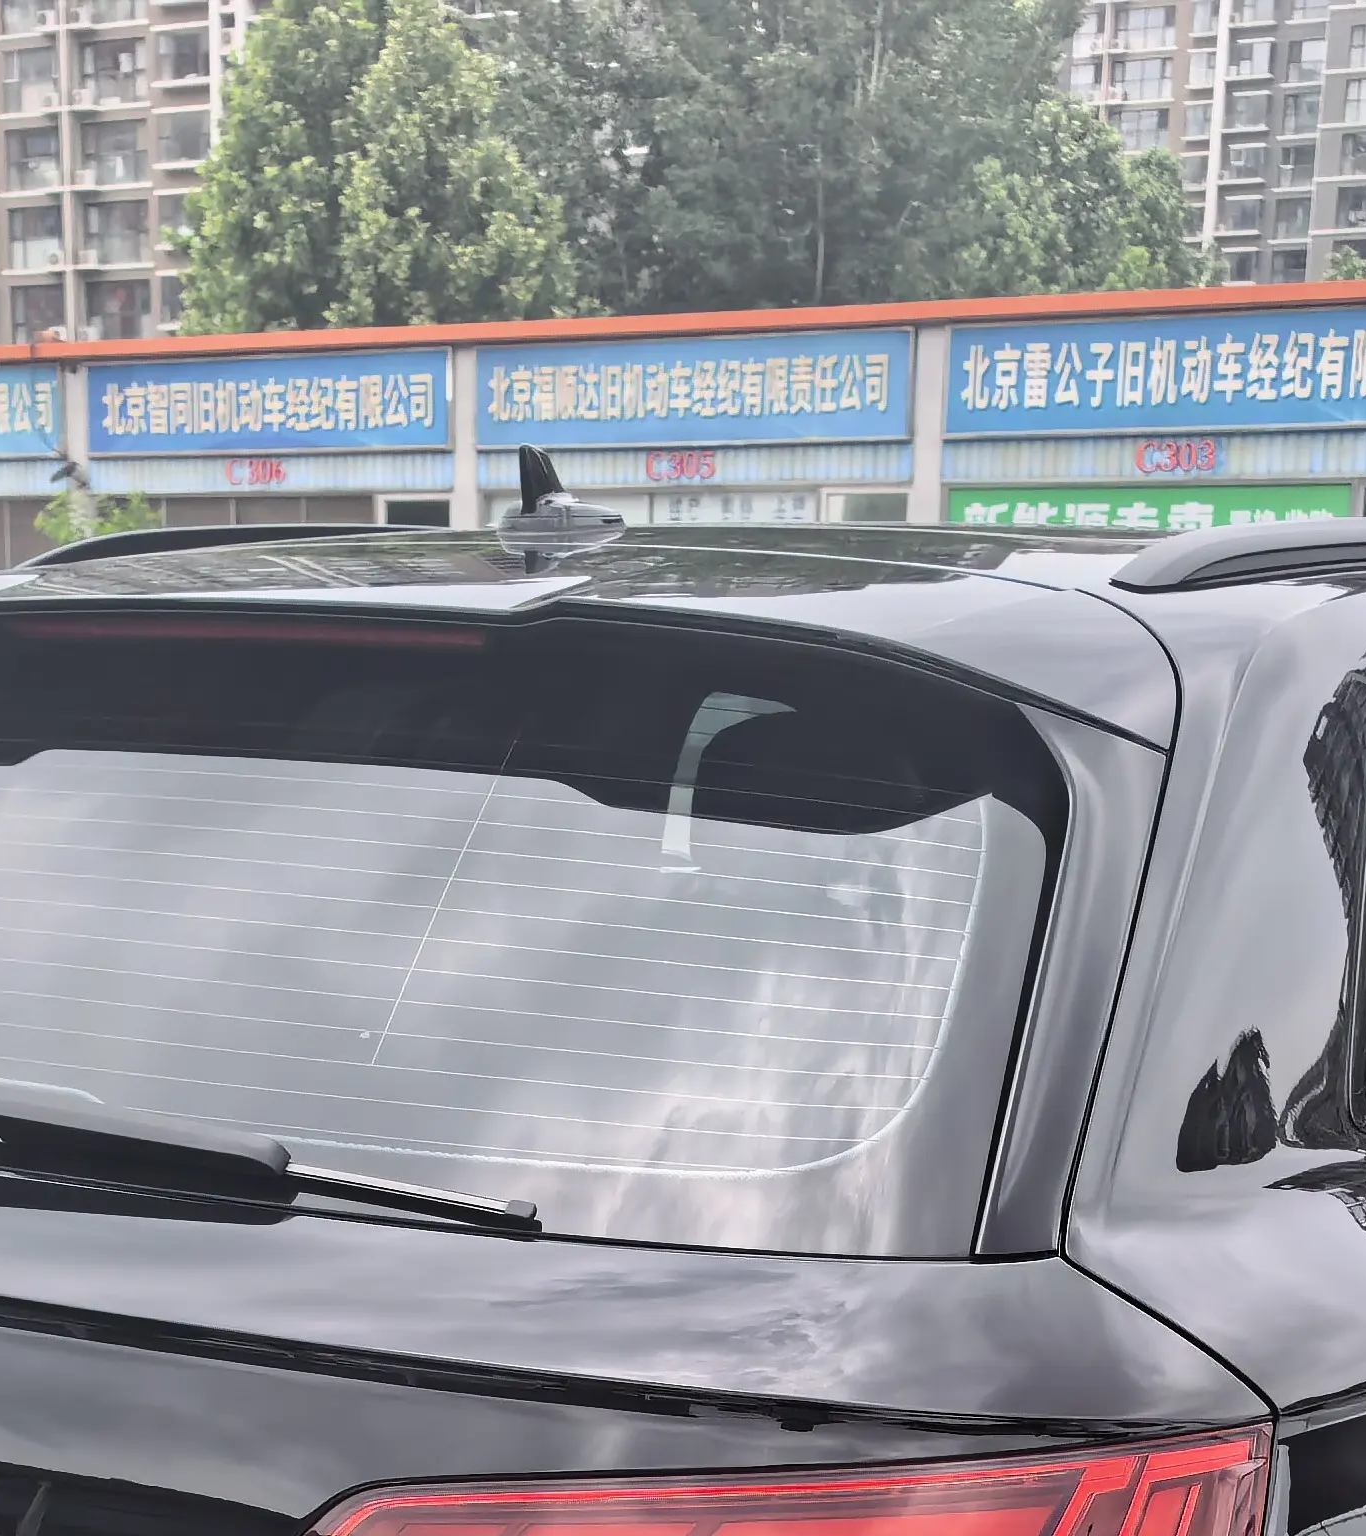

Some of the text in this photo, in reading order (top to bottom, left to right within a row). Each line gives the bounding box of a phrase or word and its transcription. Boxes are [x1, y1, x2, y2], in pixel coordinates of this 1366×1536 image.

[101, 373, 434, 436] 北京智同旧机动车经纪有限公司
[224, 458, 286, 486] C306
[645, 449, 716, 480] C305
[1135, 439, 1216, 474] C303
